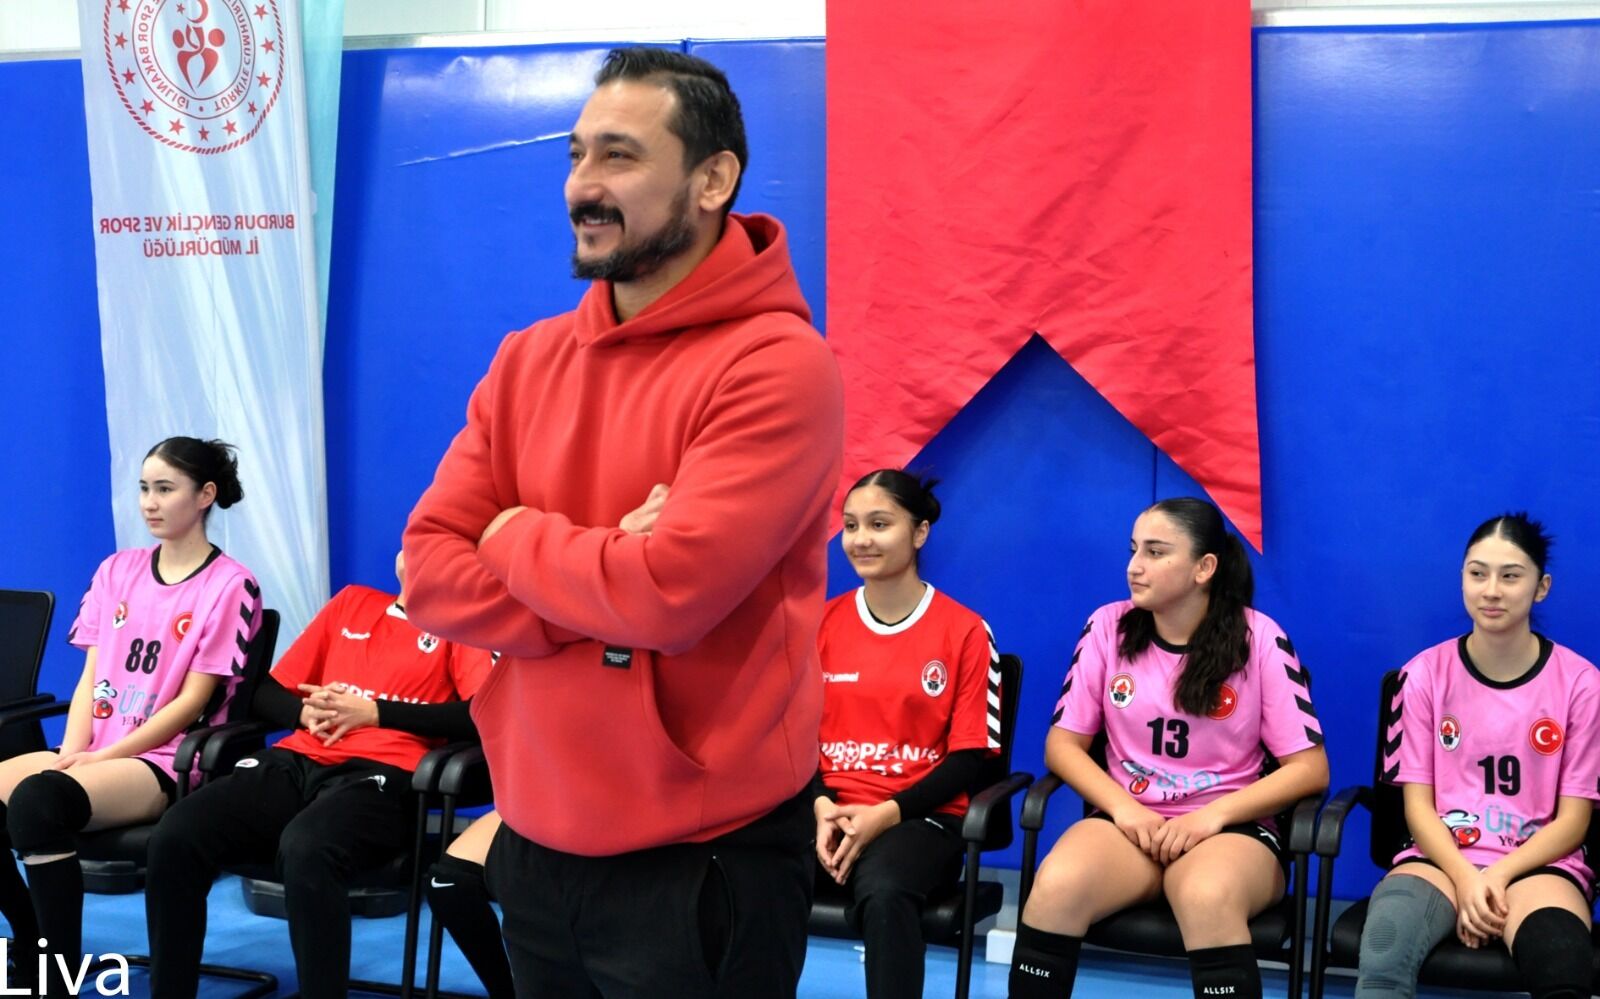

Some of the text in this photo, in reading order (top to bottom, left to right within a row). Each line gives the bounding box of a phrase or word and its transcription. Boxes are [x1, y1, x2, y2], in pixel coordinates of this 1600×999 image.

[125, 638, 161, 674] 88
[1147, 717, 1189, 759] 13
[1477, 755, 1521, 796] 19
[1019, 963, 1050, 979] ALLSIX
[1203, 986, 1235, 995] ALLSIX
